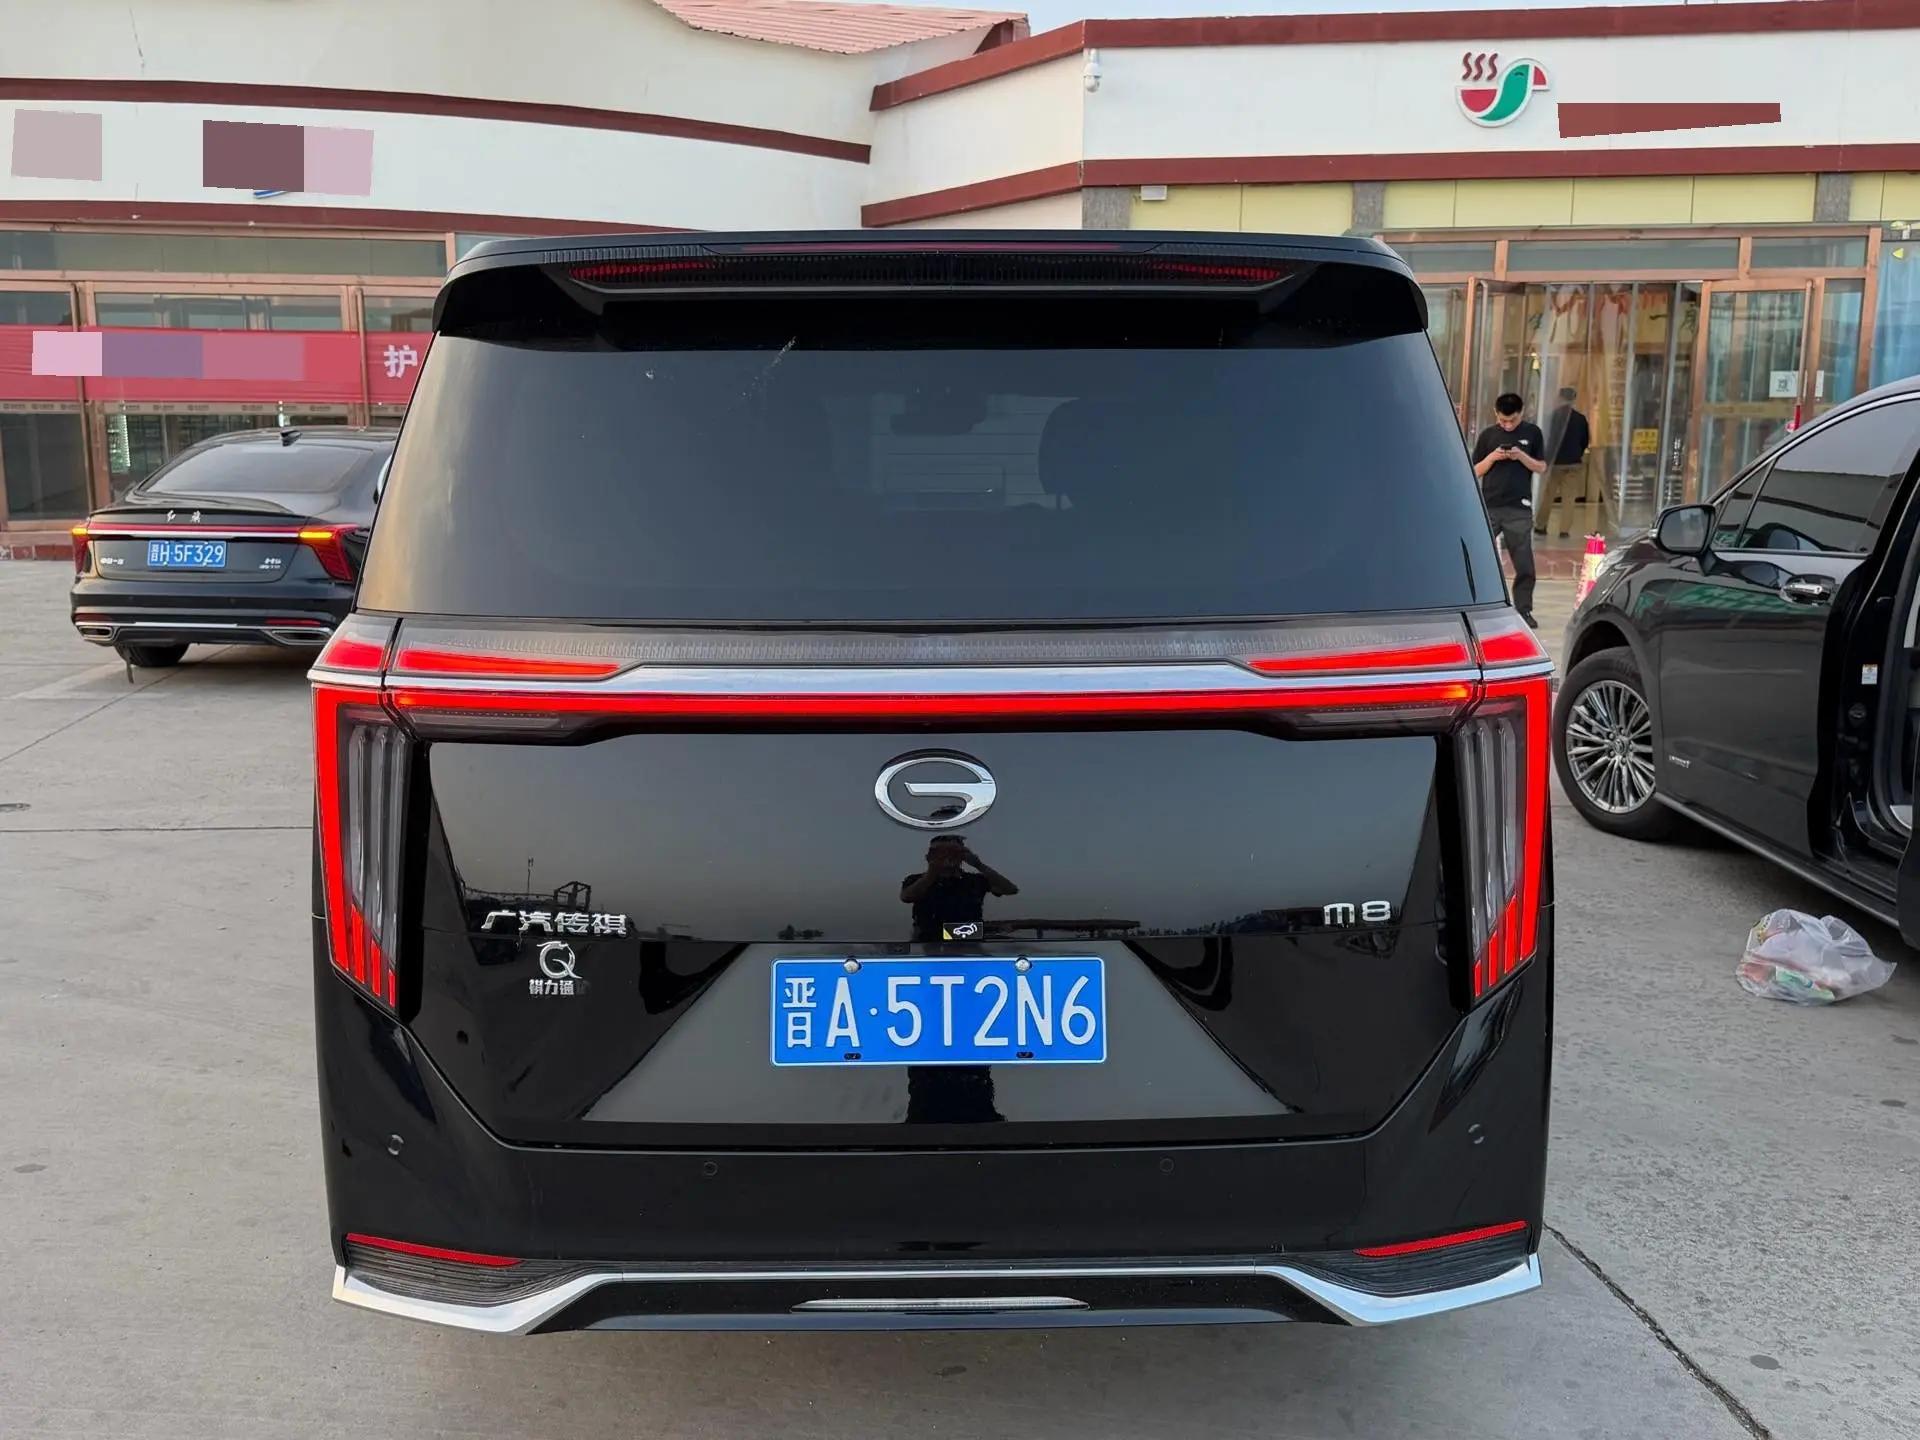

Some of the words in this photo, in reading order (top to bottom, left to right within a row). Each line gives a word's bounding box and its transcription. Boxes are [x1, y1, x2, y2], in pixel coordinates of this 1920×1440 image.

[383, 344, 418, 379] 护
[481, 909, 627, 936] 广汽传祺
